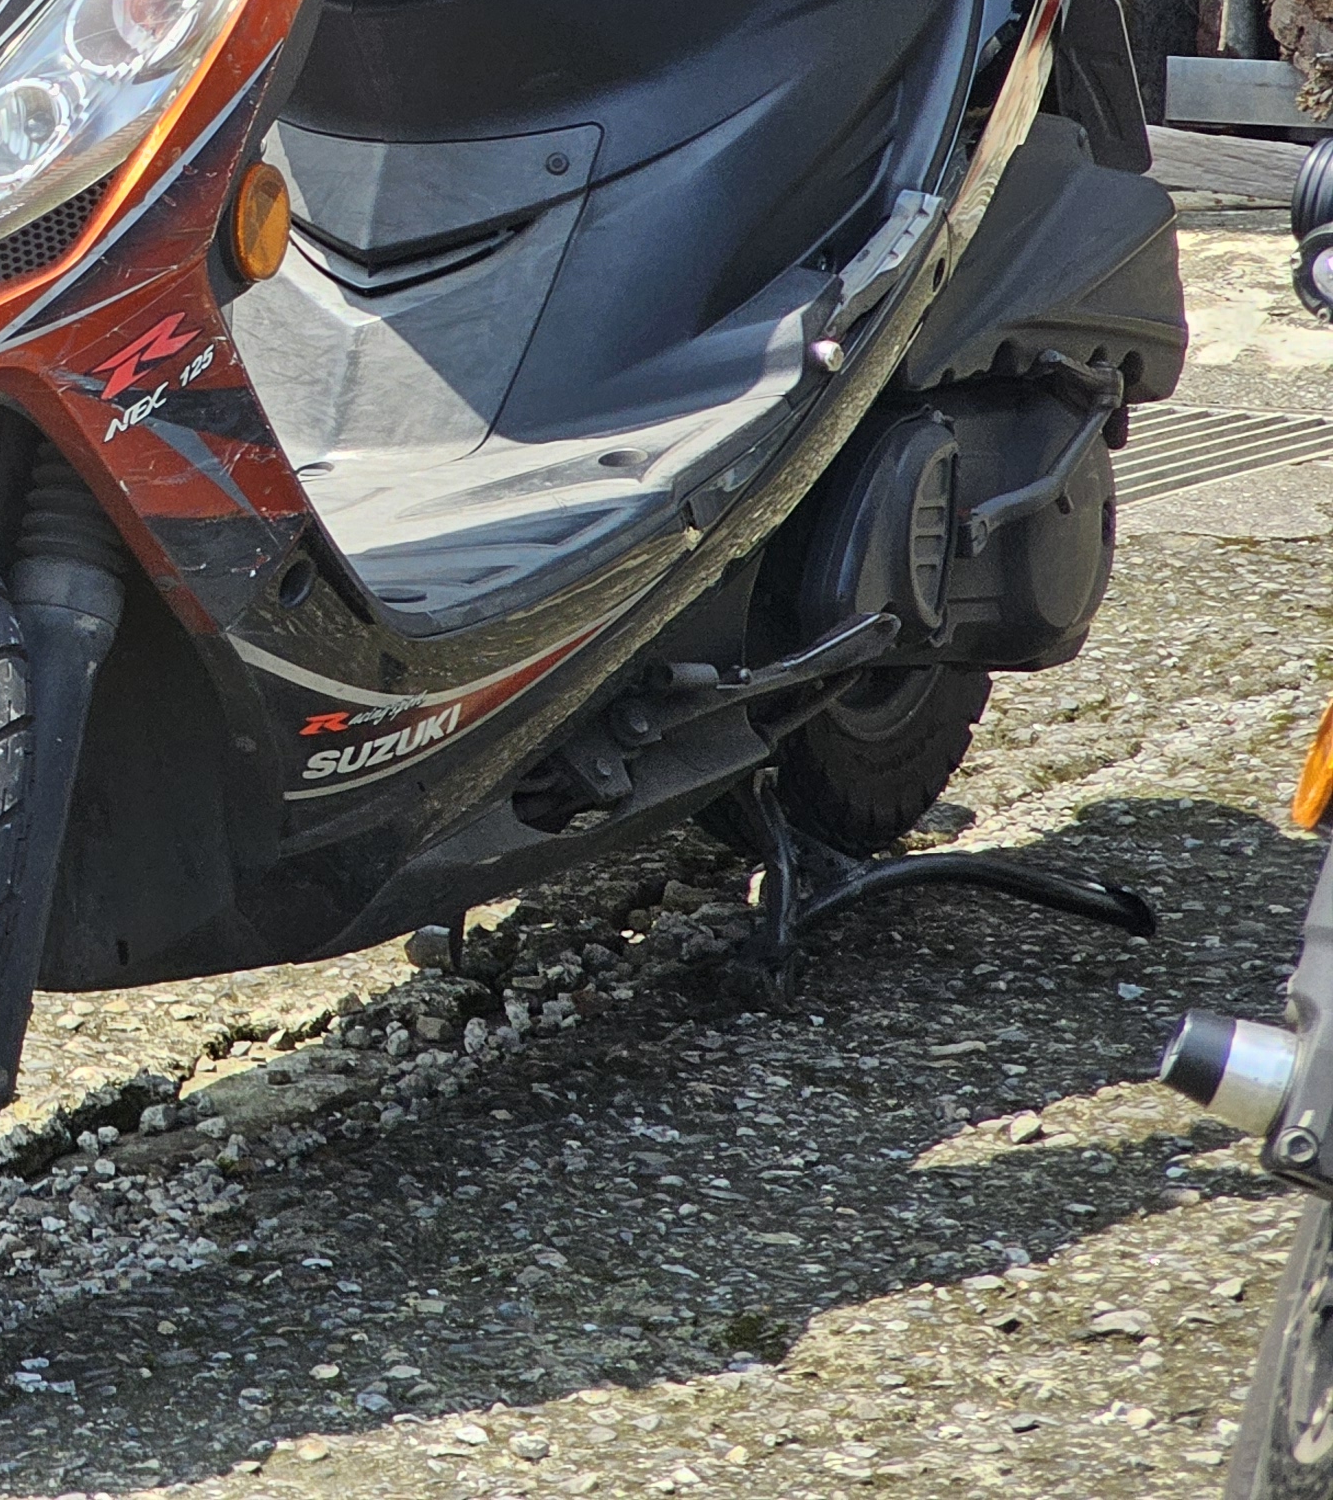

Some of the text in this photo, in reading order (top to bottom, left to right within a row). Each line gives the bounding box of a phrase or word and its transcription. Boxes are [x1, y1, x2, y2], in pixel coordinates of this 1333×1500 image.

[103, 343, 215, 443] NEX 125
[301, 703, 463, 780] SUZUKI
